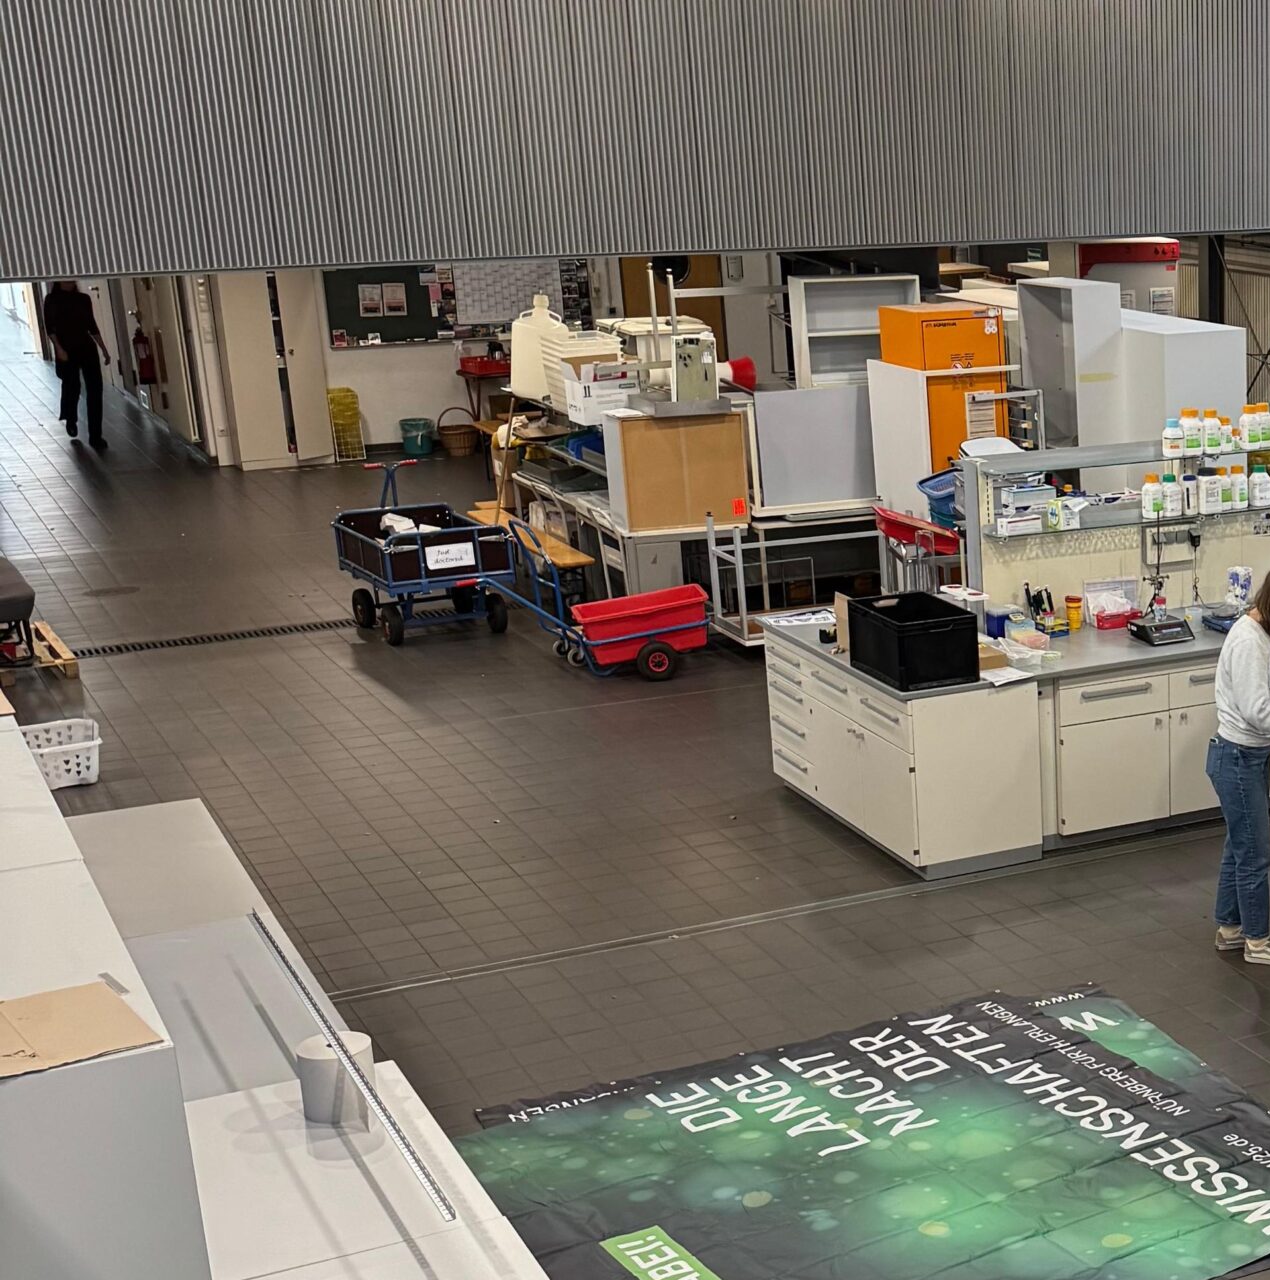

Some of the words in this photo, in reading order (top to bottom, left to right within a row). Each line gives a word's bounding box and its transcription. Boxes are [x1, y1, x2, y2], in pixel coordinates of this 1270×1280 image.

[975, 1000, 1058, 1048] ERLANGEN
[849, 1027, 951, 1082] DER
[1048, 1037, 1105, 1074] FÜRTH
[645, 1082, 743, 1133] DIE
[710, 1064, 871, 1157] LANGE
[778, 1052, 940, 1136] NACHT
[1100, 1063, 1191, 1117] NÜRNBERG
